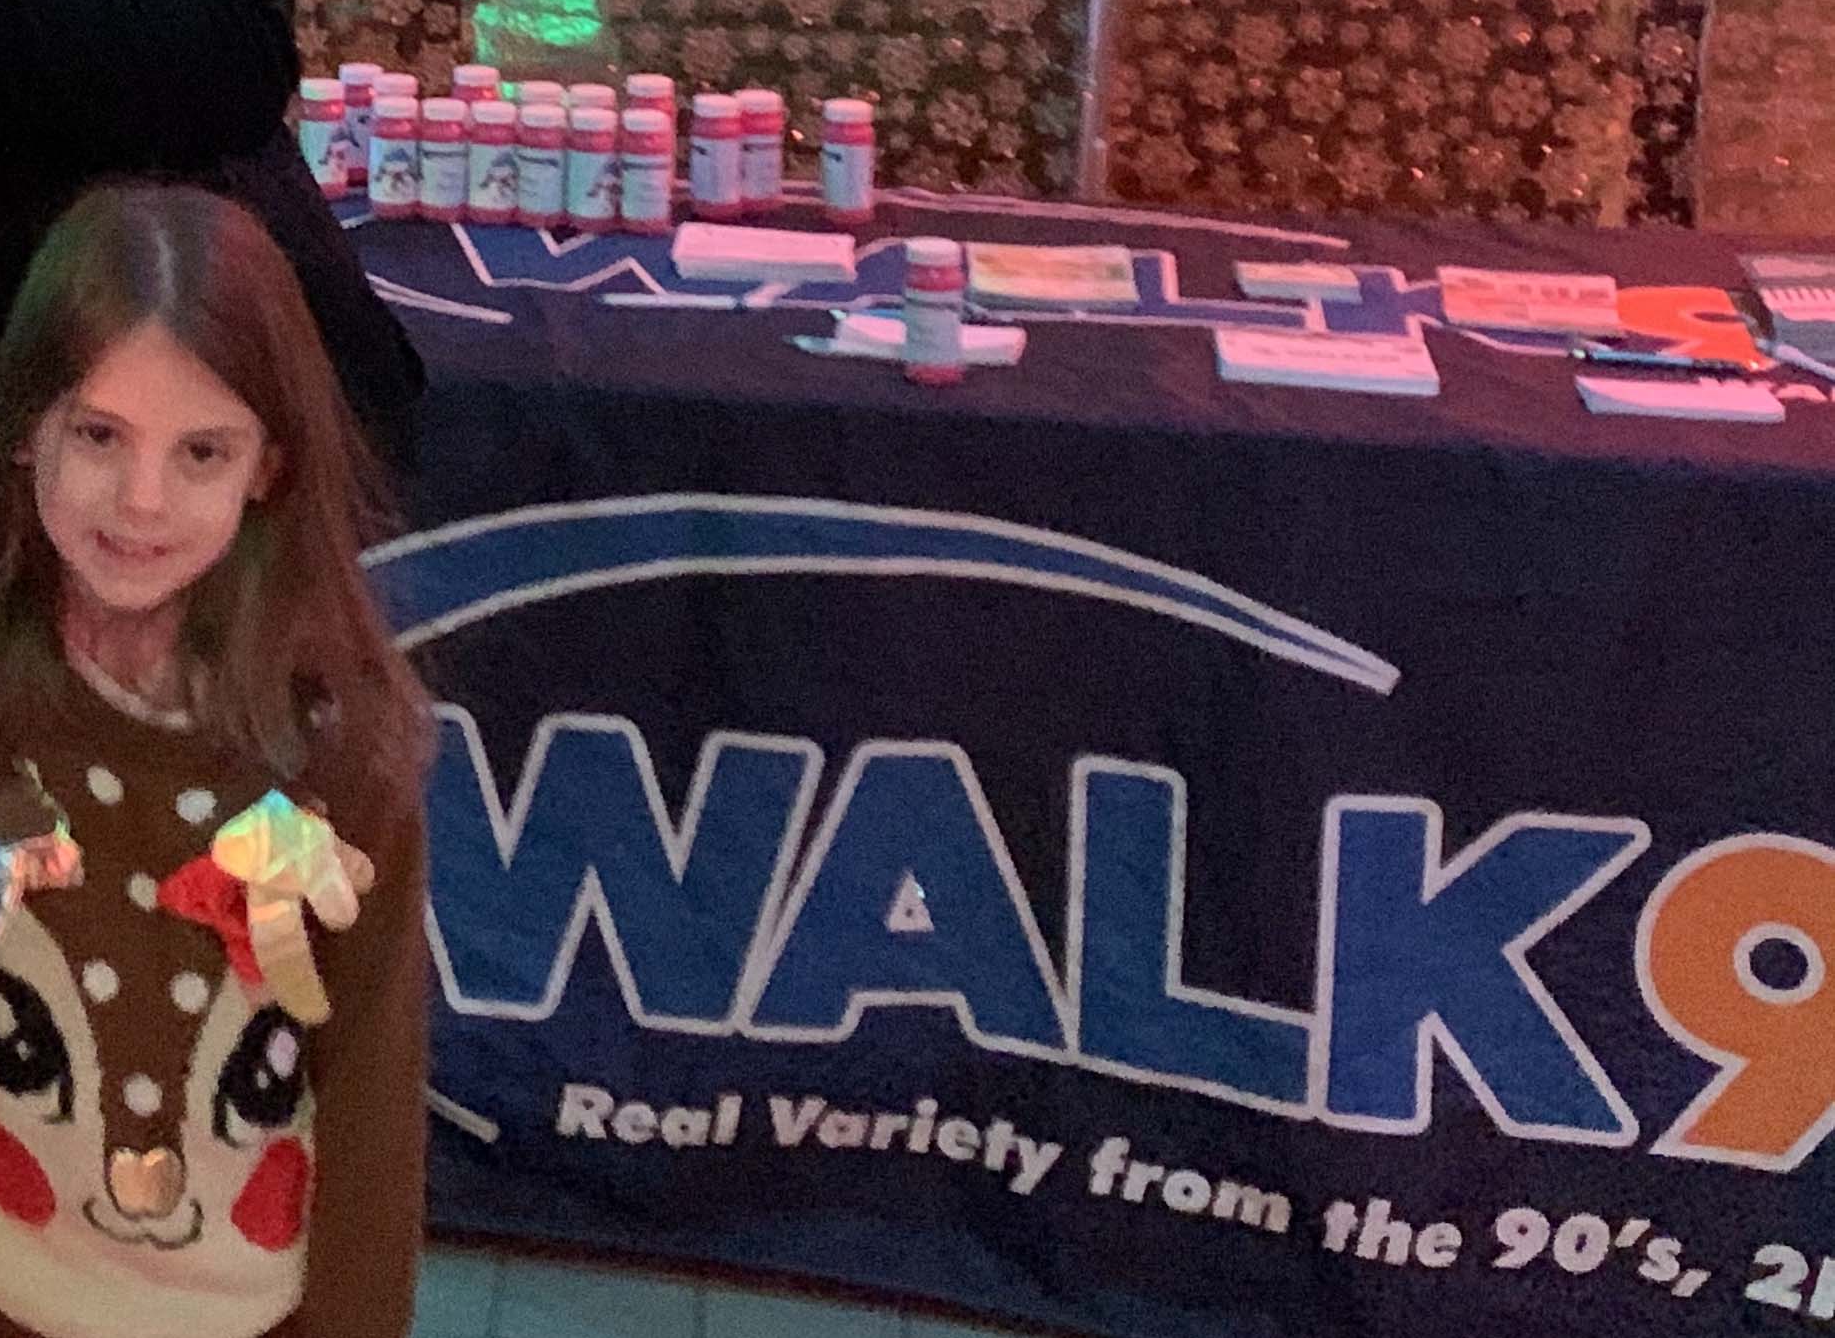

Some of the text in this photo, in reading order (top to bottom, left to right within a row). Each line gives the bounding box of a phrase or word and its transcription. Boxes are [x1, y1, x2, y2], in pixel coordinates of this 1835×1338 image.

[424, 701, 1652, 1148] WALK
[556, 1082, 743, 1147] Real
[769, 1095, 1062, 1195] Variety
[1089, 1135, 1292, 1233] from
[1323, 1197, 1463, 1268] the
[1493, 1206, 1712, 1298] 90's,
